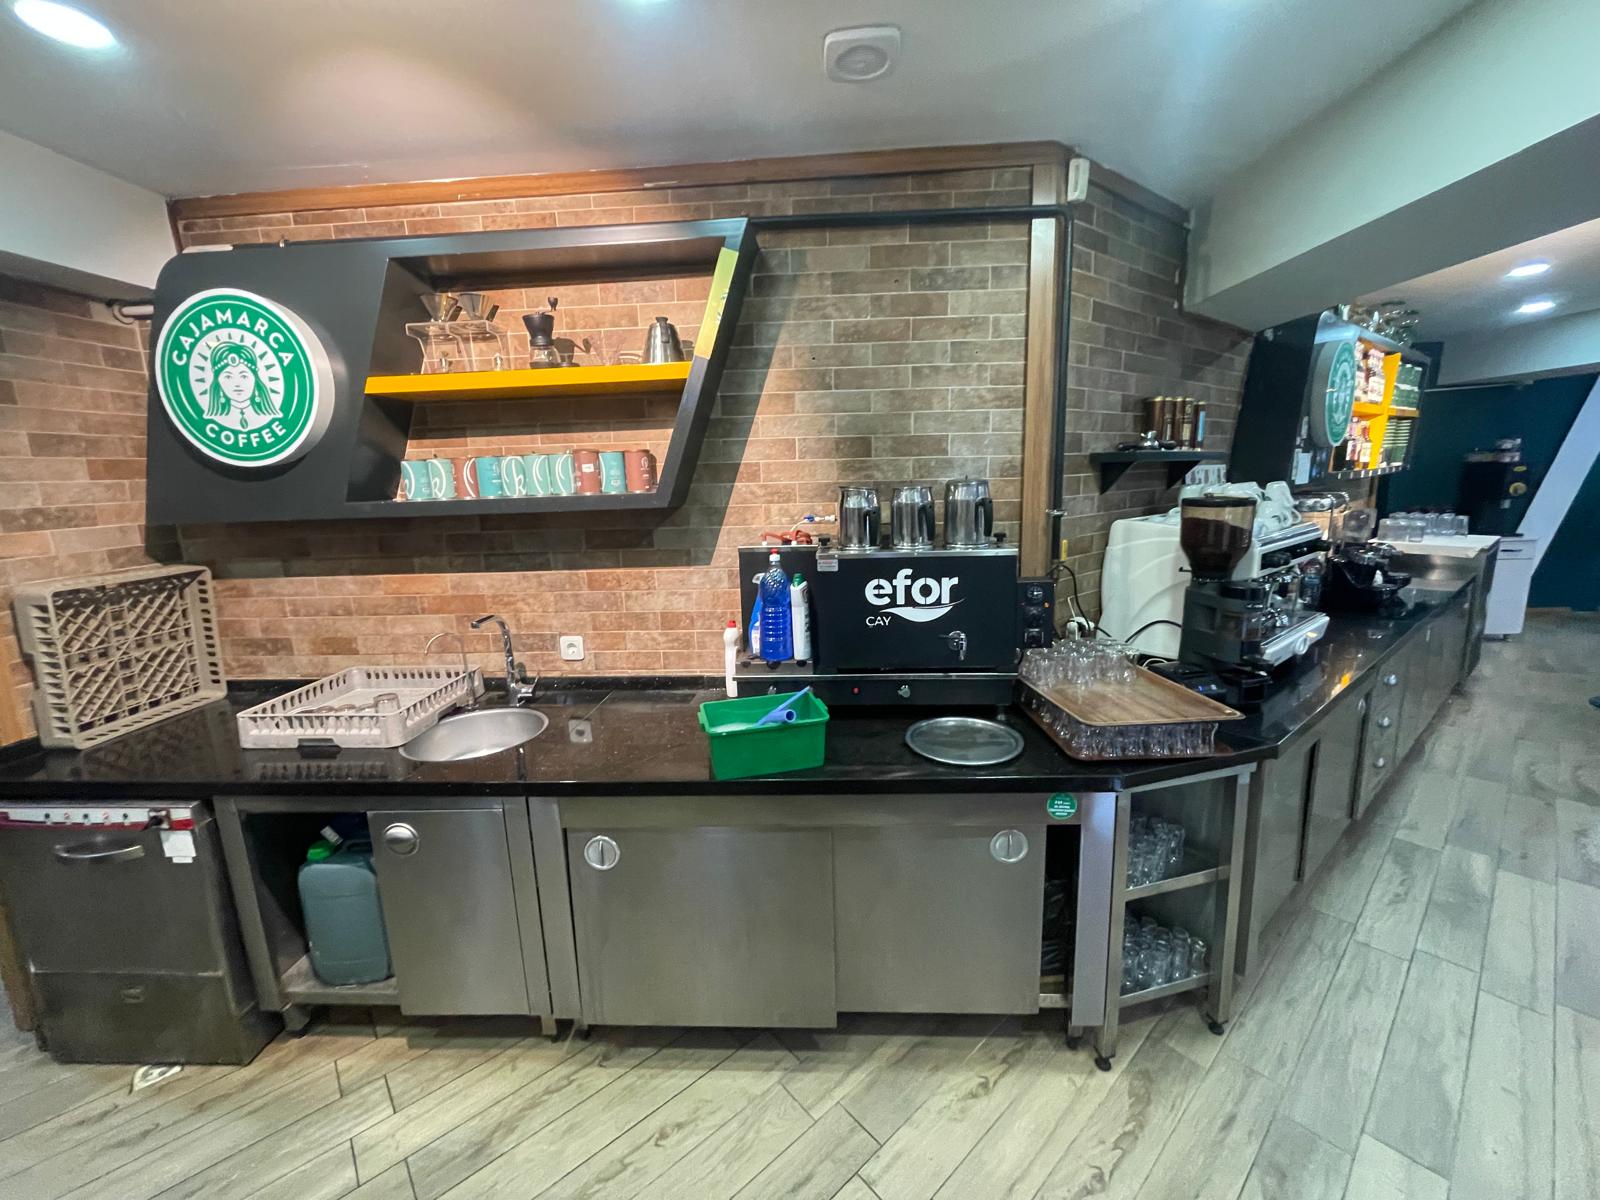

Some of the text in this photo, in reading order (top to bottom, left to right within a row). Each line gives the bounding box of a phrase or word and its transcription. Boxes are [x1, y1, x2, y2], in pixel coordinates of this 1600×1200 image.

[172, 308, 295, 367] CAJAMARCA
[205, 421, 287, 448] COFFEE
[865, 568, 959, 606] efor
